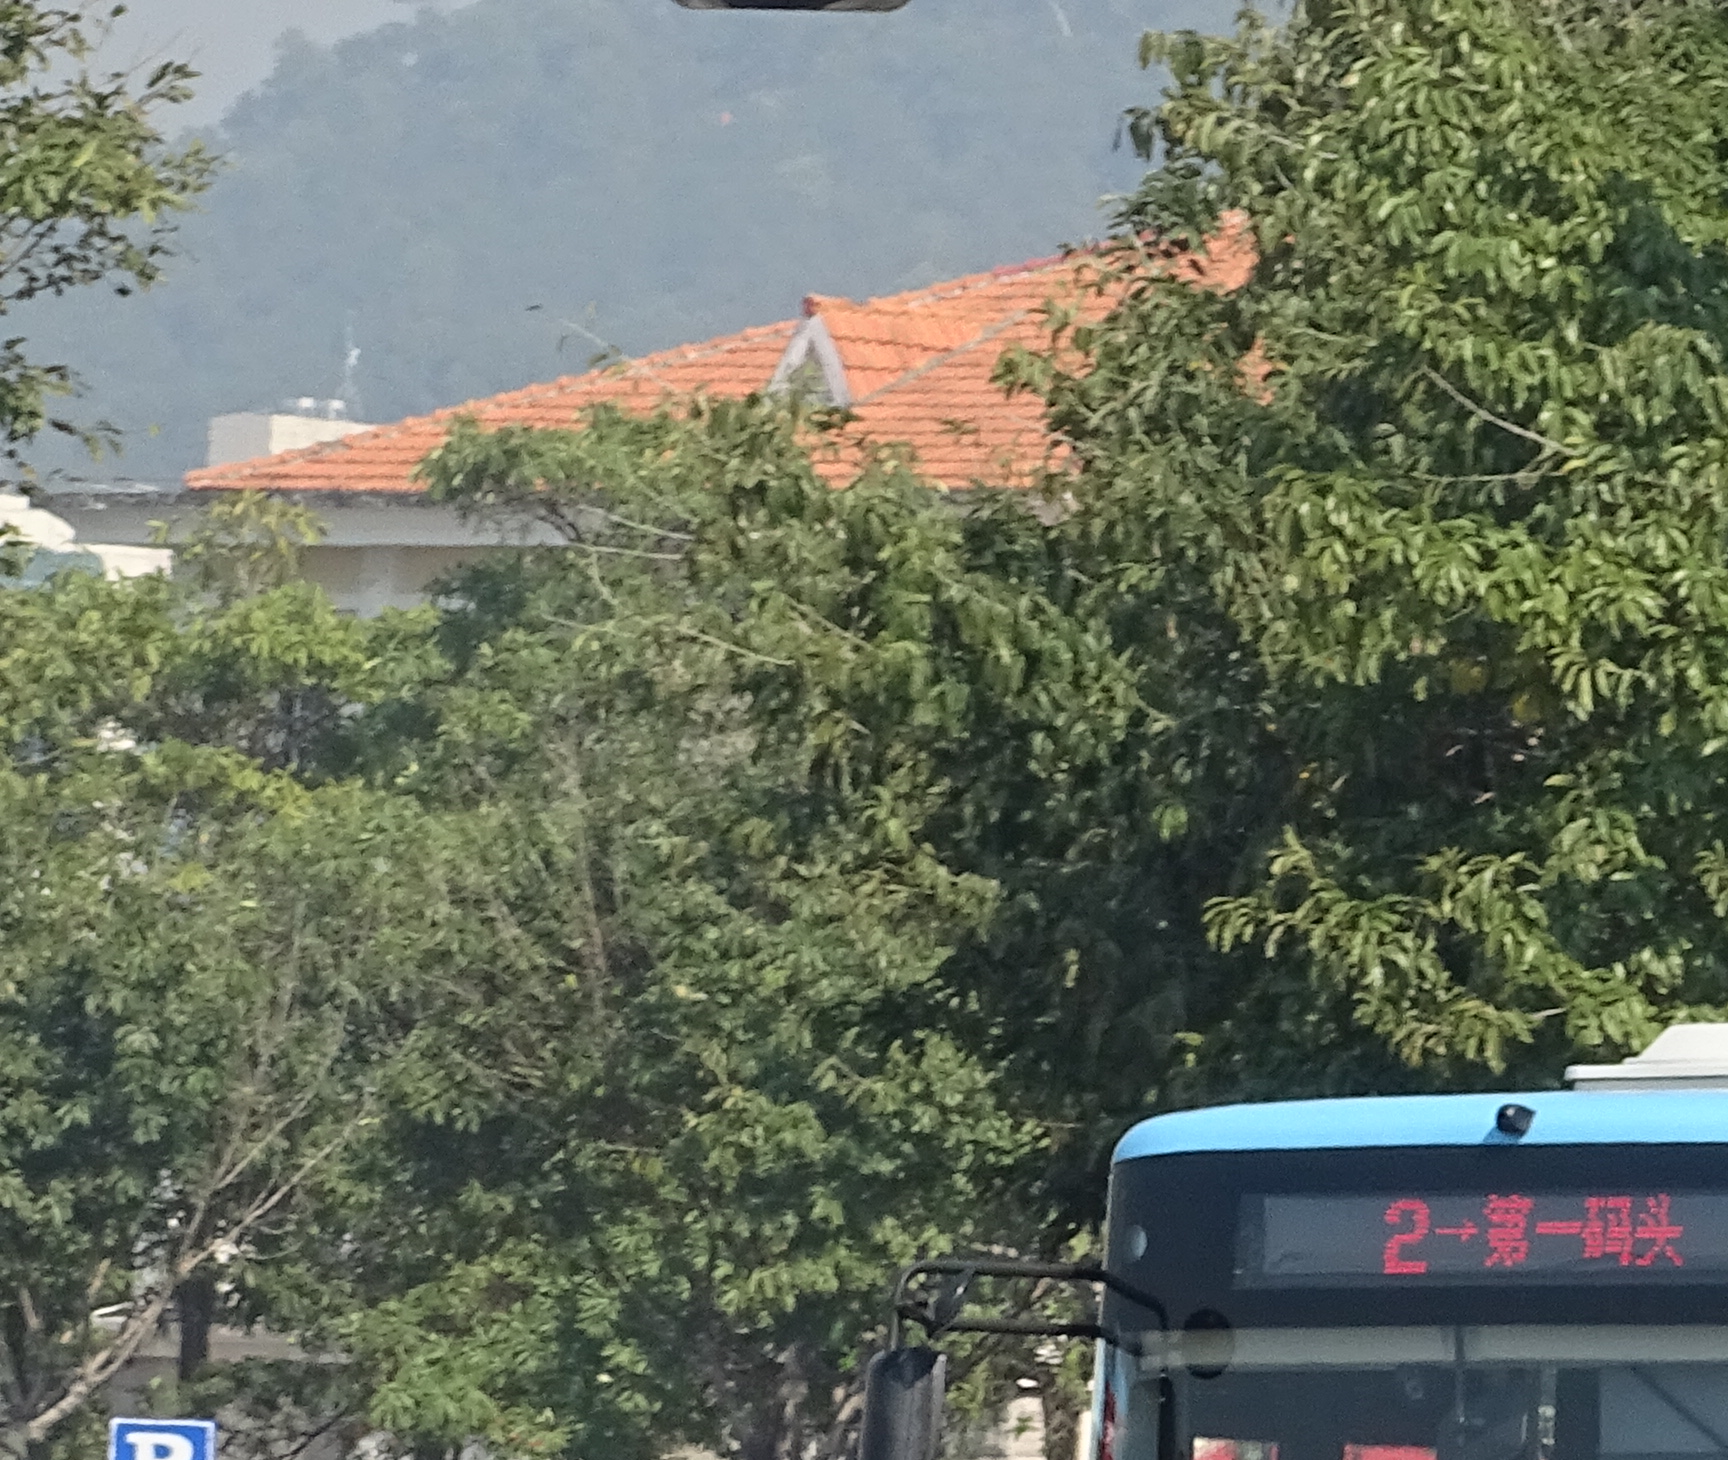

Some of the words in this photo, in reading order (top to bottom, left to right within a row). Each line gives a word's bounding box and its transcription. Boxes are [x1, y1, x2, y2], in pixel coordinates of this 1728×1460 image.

[1383, 1197, 1430, 1275] 2
[1483, 1193, 1685, 1268] 第一码头
